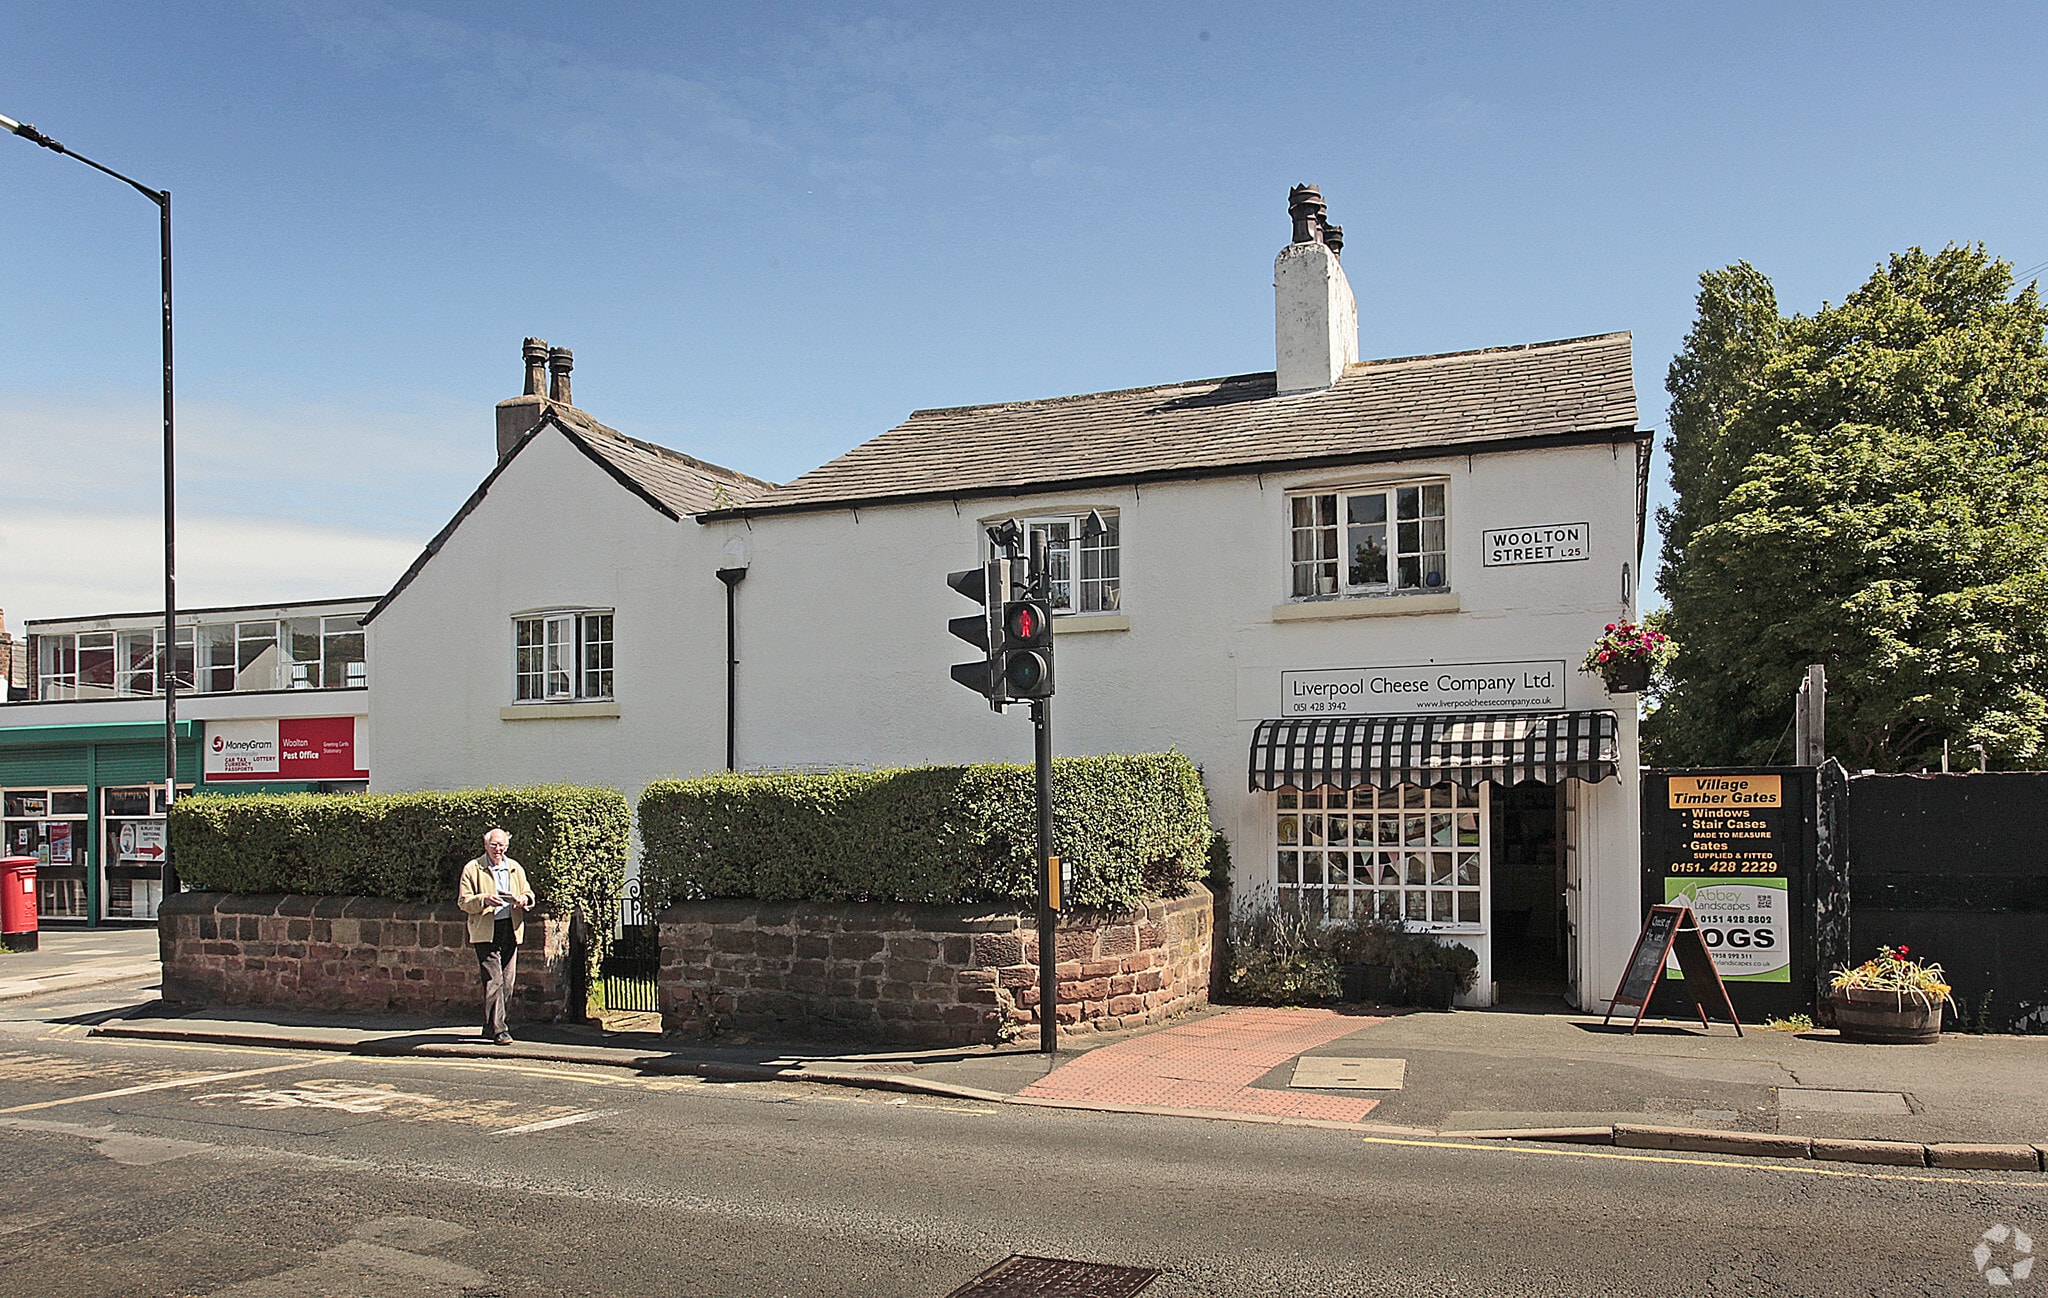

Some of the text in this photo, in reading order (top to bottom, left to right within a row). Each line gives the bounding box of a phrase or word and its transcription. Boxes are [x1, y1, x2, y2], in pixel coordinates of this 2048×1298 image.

[1493, 528, 1579, 547] WOOLTON
[1492, 546, 1581, 562] STREET L25
[1293, 671, 1555, 700] Liverpool Cheese Company Ltd.
[1293, 702, 1347, 712] 0151 428 3942
[1416, 696, 1552, 709] www.liverpoolcheesecompany.co.uk
[225, 740, 272, 751] MoneyGram
[282, 738, 309, 747] Woolton
[283, 750, 320, 760] Post Office
[1696, 779, 1749, 792] Village
[1674, 792, 1777, 804] Timber Gates
[1692, 809, 1750, 818] Windows
[1692, 819, 1767, 829] Stair Cases
[1690, 841, 1728, 850] Gates
[1671, 861, 1778, 873] 0151. 428 2229
[1695, 889, 1741, 902] Abbey
[1695, 901, 1751, 911] Landscapes
[1701, 915, 1772, 924] 0151 428 8802
[1702, 928, 1775, 948] OGS
